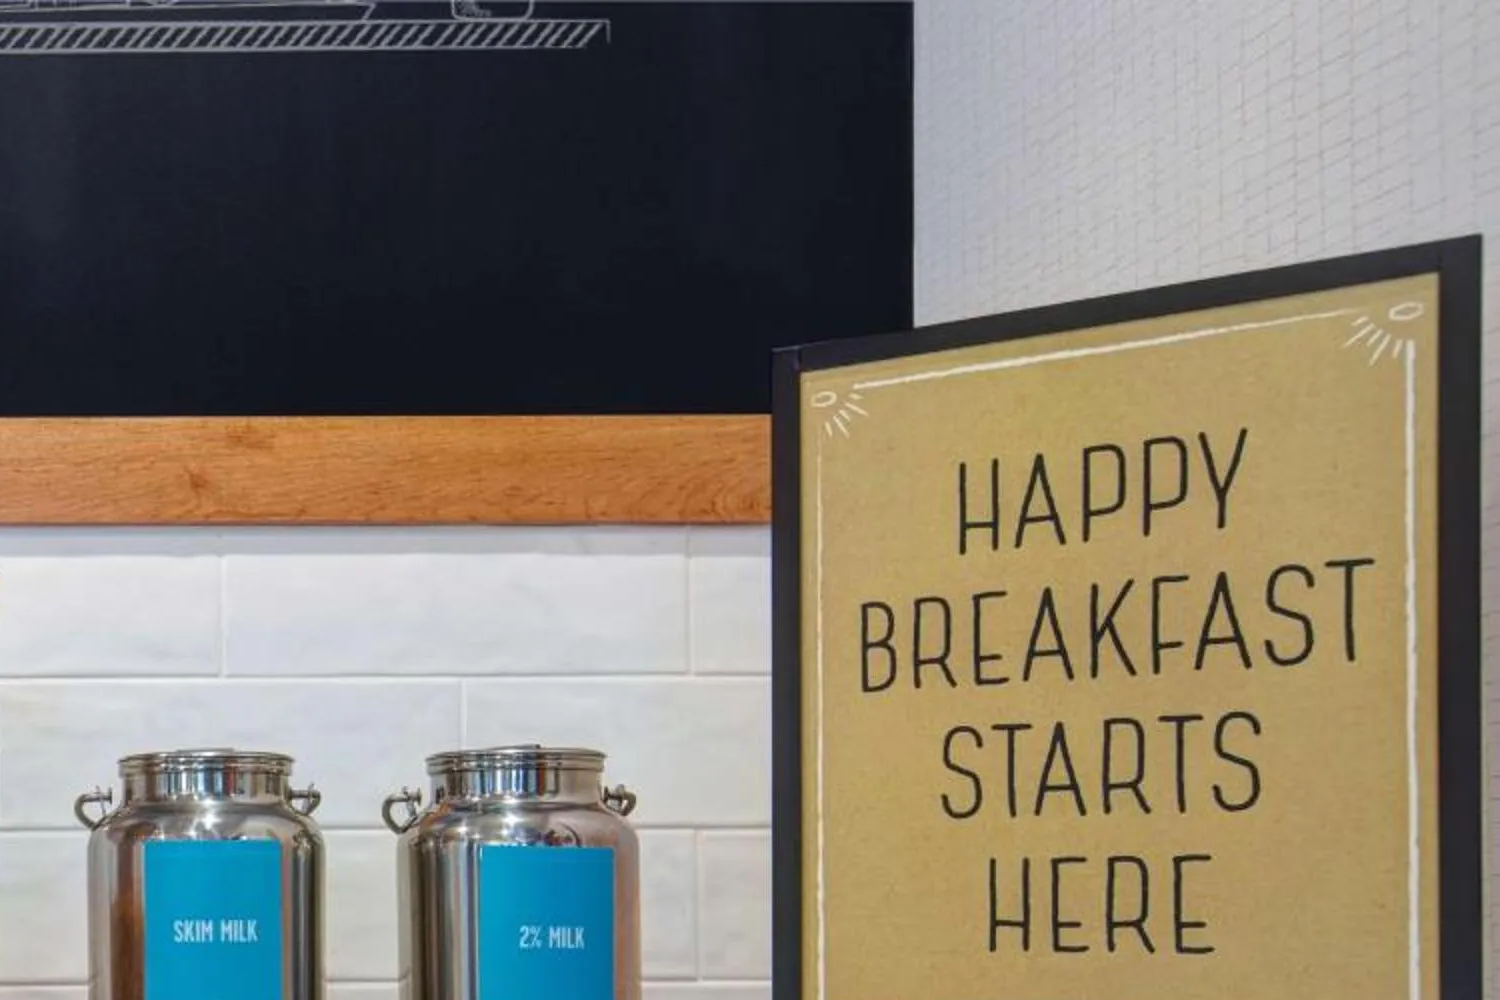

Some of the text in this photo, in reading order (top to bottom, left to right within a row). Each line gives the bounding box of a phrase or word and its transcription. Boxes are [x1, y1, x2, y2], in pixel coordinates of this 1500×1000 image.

[957, 427, 1248, 556] HAPPY
[860, 558, 1375, 693] BREAKFAST
[940, 710, 1263, 820] STARTS
[173, 919, 258, 943] SKIM MILK
[519, 926, 585, 949] 2% MILK
[987, 855, 1216, 955] HERE
